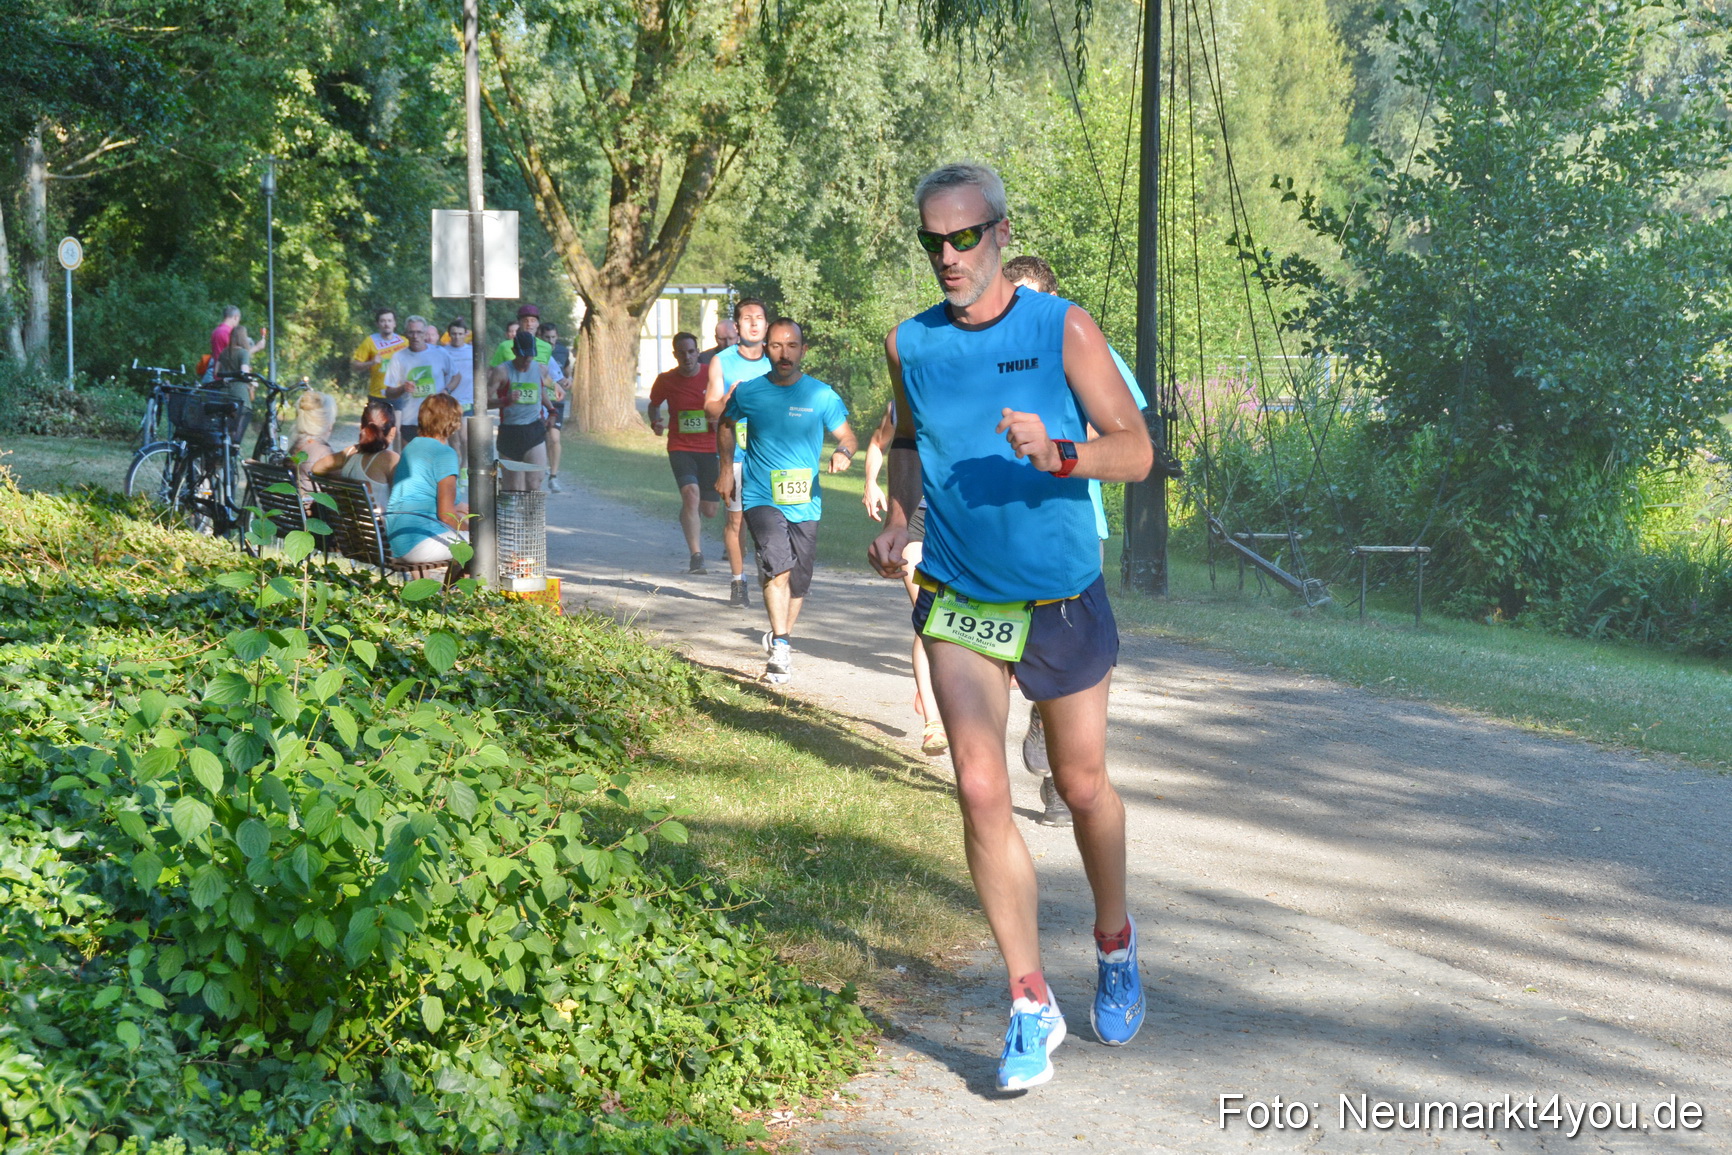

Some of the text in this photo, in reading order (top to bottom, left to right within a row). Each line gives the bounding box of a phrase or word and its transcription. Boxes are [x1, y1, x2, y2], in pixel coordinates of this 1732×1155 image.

[997, 357, 1038, 373] THULE
[683, 418, 701, 427] 453
[778, 481, 807, 494] 1533
[944, 612, 1014, 643] 1938
[952, 629, 996, 647] Ridzal Muris
